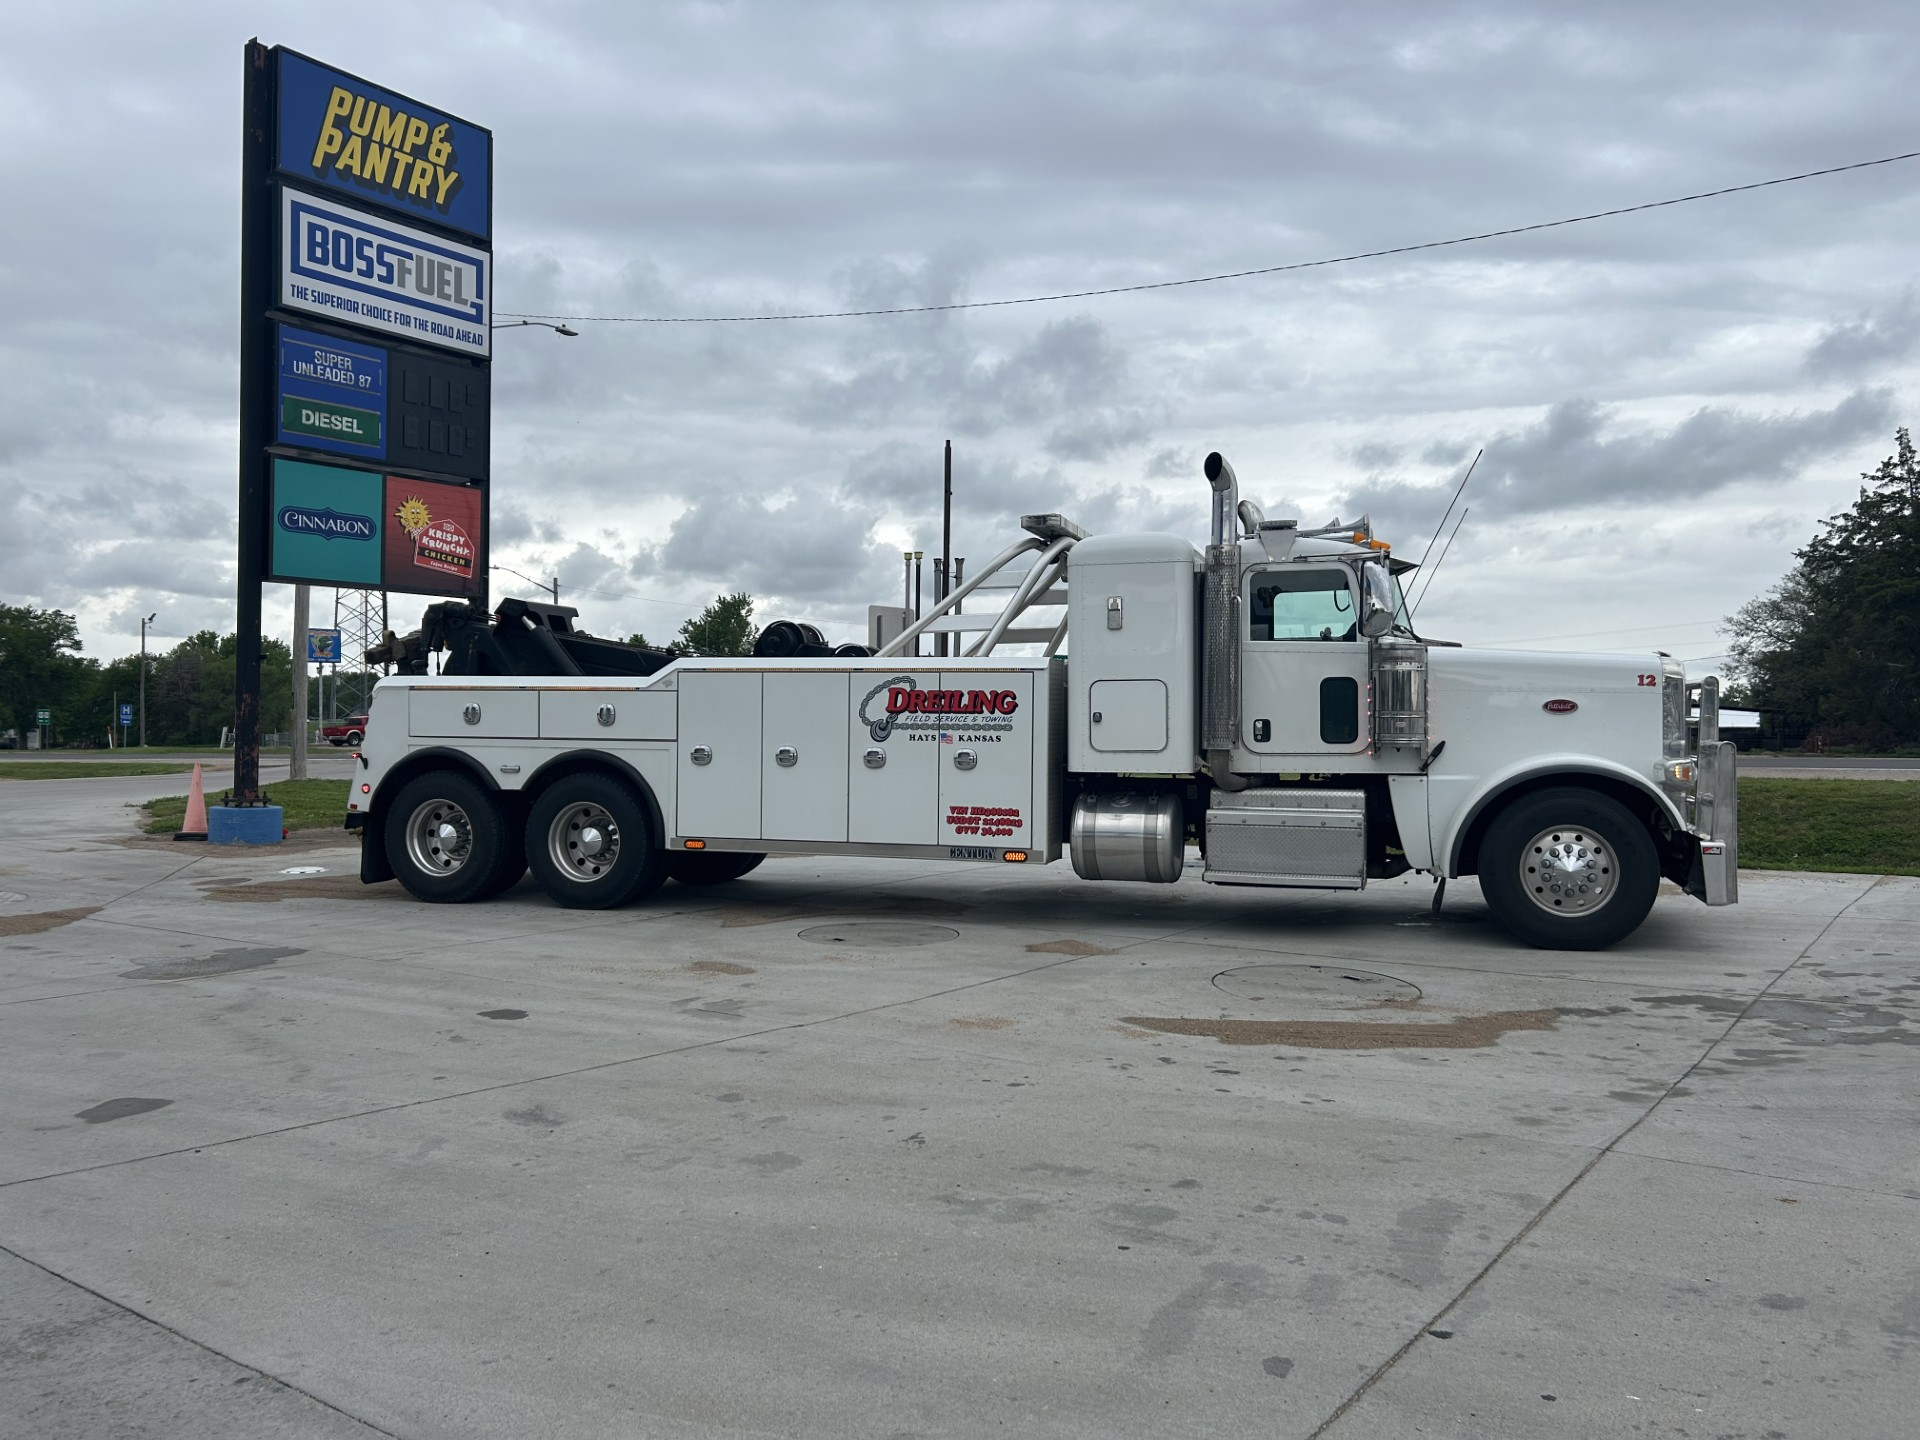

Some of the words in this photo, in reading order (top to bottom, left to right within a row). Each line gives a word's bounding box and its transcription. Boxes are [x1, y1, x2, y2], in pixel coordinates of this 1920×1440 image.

[325, 86, 429, 154] PUMP
[428, 122, 453, 167] &
[312, 127, 459, 205] PANTRY
[307, 221, 469, 306] BOSSFUEL
[291, 284, 309, 301] THE
[311, 290, 360, 314] SUPERIOR
[361, 304, 393, 322] CHOICE
[394, 313, 411, 328] FOR
[413, 317, 430, 332] THE
[430, 324, 454, 339] ROAD
[455, 332, 484, 346] AHEAD
[314, 350, 352, 371] SUPER
[293, 360, 355, 385] UNLEADED
[358, 375, 372, 388] 87
[301, 408, 363, 434] DIESEL
[428, 528, 465, 545] KRISPY
[421, 535, 470, 556] KRUNCHY
[424, 549, 466, 565] CHICKEN
[1637, 674, 1656, 687] 12
[123, 706, 130, 714] H
[933, 715, 969, 723] SERVICE
[958, 734, 1002, 743] KANSAS
[949, 806, 969, 815] VIN
[946, 815, 981, 825] USDOT
[955, 825, 980, 835] GVW
[949, 847, 996, 859] CENTURY
